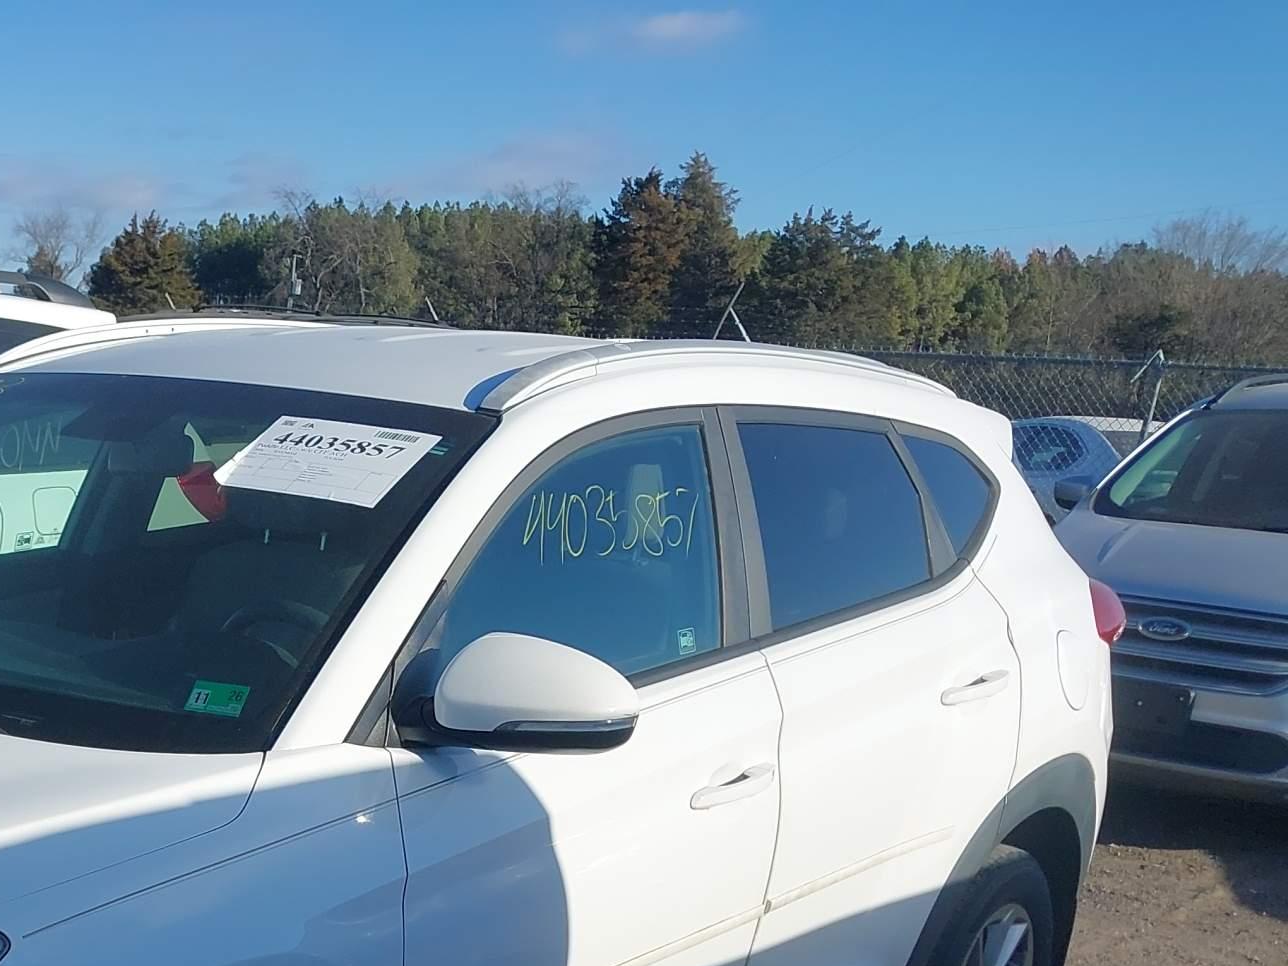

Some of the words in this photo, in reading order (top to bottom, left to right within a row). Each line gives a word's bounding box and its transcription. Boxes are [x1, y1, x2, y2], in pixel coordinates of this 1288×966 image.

[274, 432, 407, 459] 44035857
[522, 484, 700, 566] 44035857
[194, 691, 210, 705] 11
